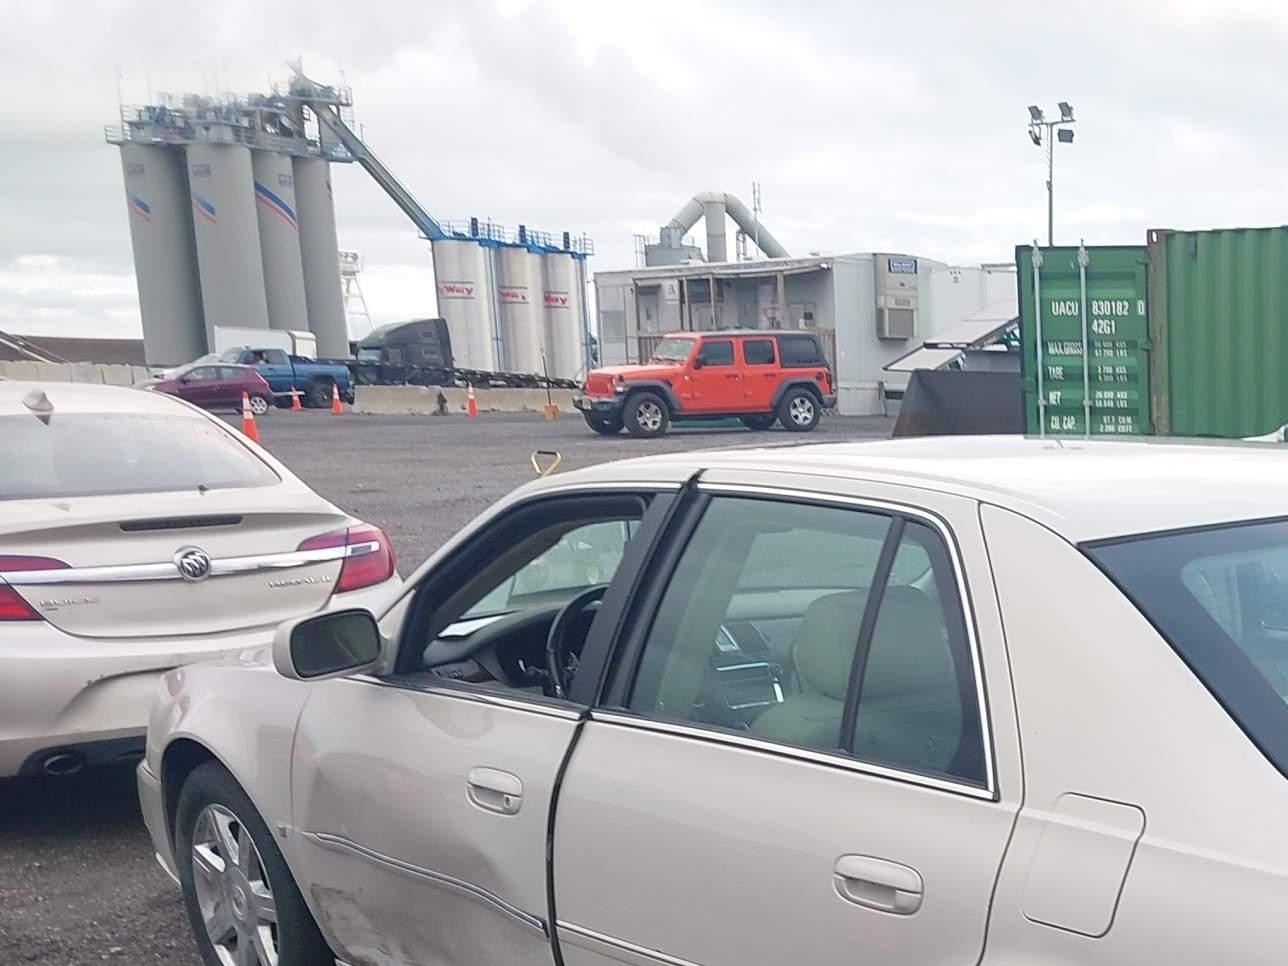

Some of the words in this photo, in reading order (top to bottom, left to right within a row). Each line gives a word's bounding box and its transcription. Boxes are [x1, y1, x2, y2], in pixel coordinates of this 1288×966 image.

[1051, 300, 1078, 316] UACU
[1092, 300, 1129, 316] 830182
[1092, 319, 1116, 334] 42G1
